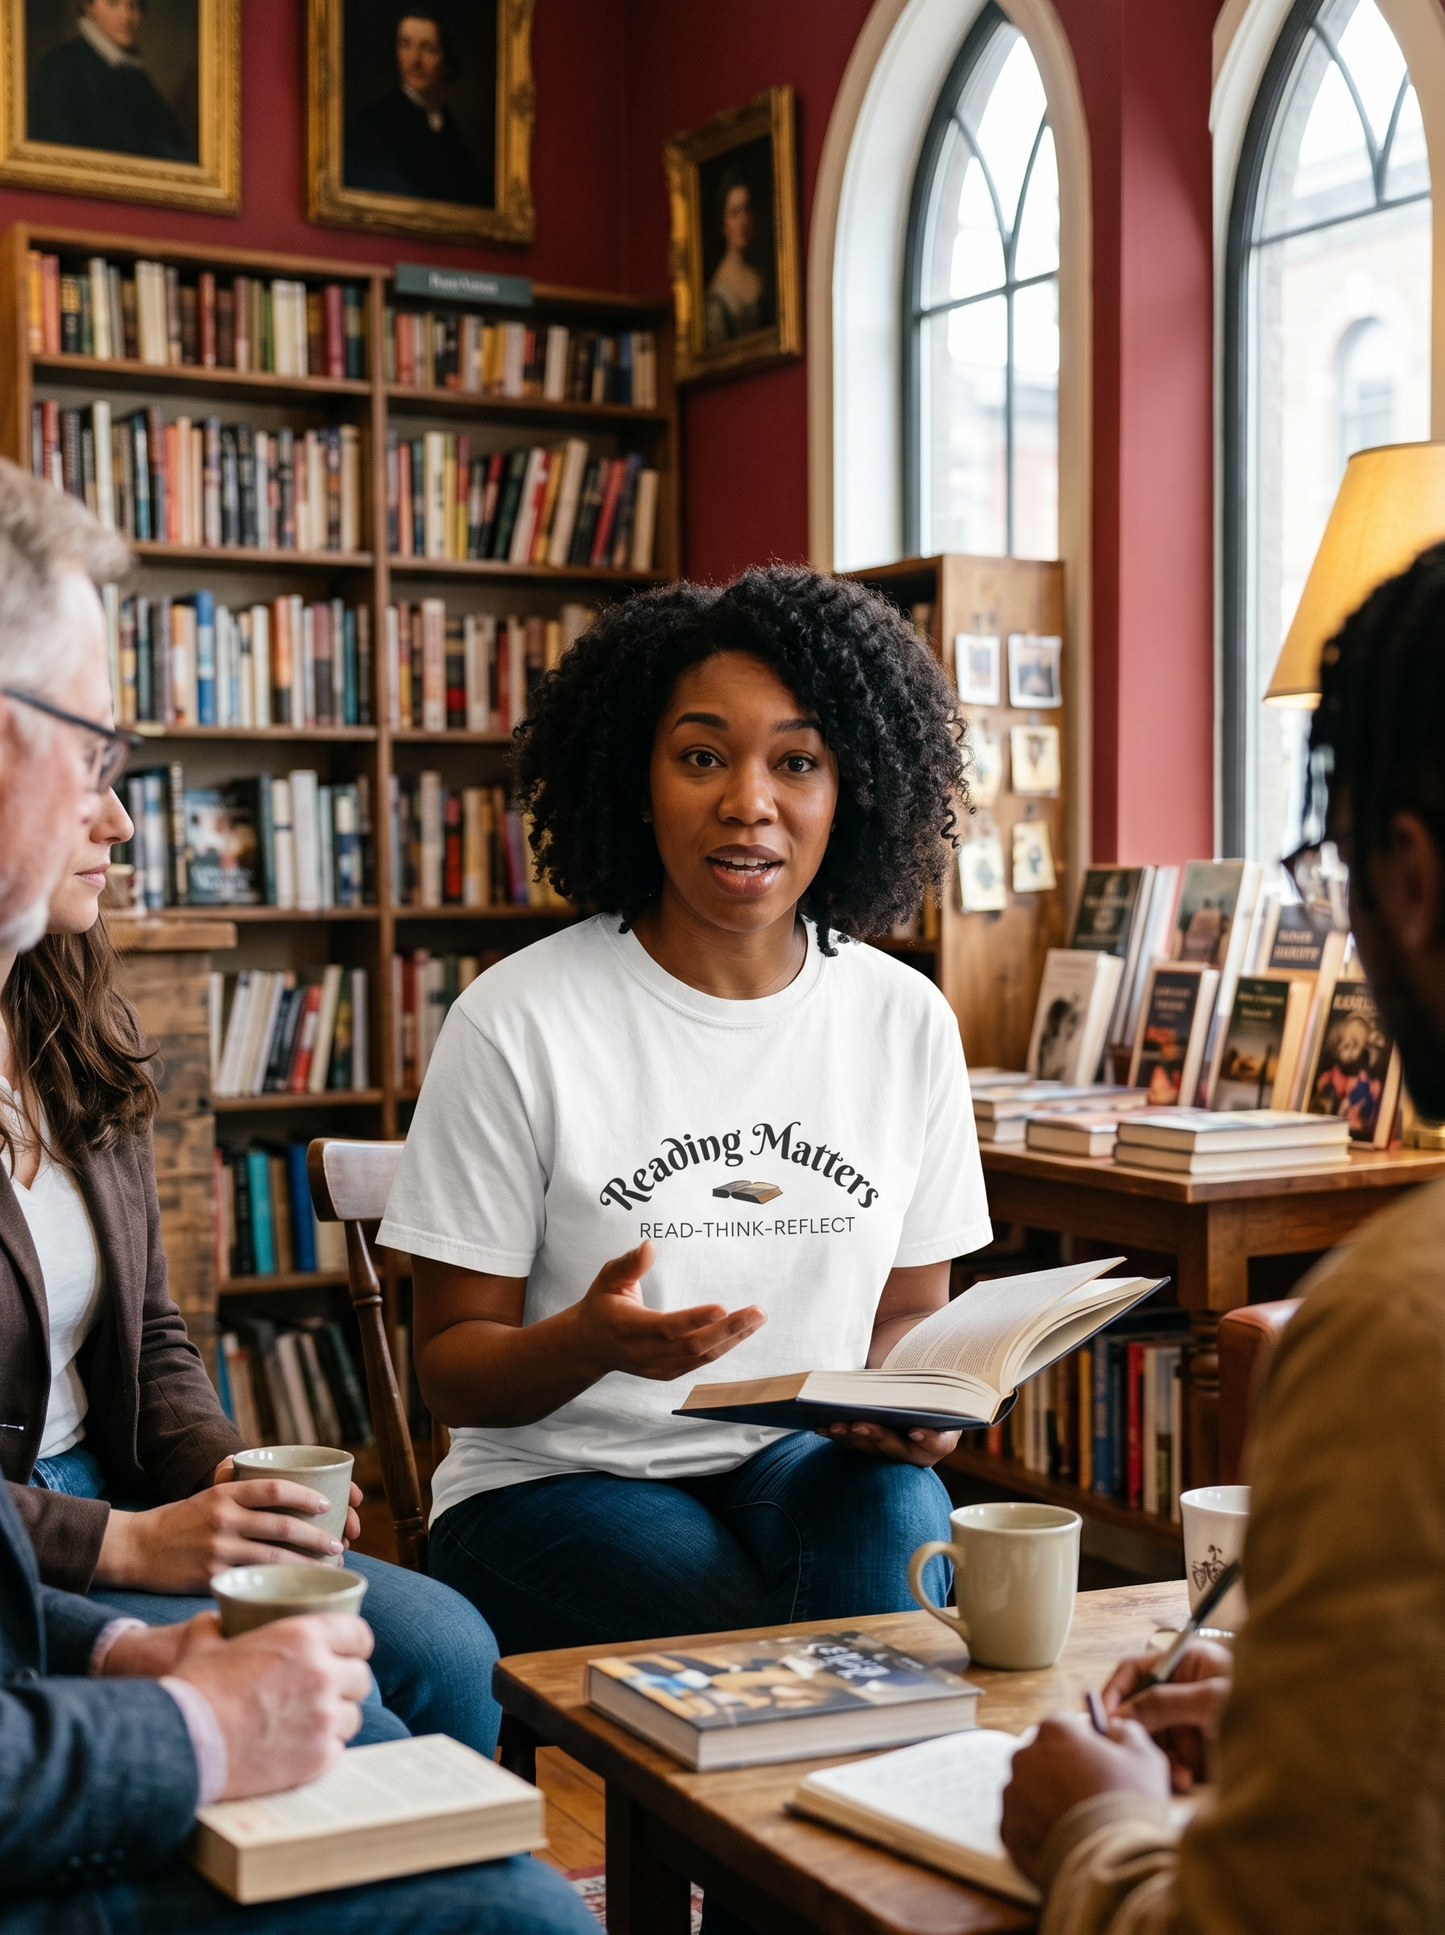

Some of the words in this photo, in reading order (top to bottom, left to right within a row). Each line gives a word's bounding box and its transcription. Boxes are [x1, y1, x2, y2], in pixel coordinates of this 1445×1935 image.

[600, 1129, 744, 1211] Reading
[749, 1121, 879, 1208] Matters
[639, 1216, 856, 1239] READ-THINK-REFLECT
